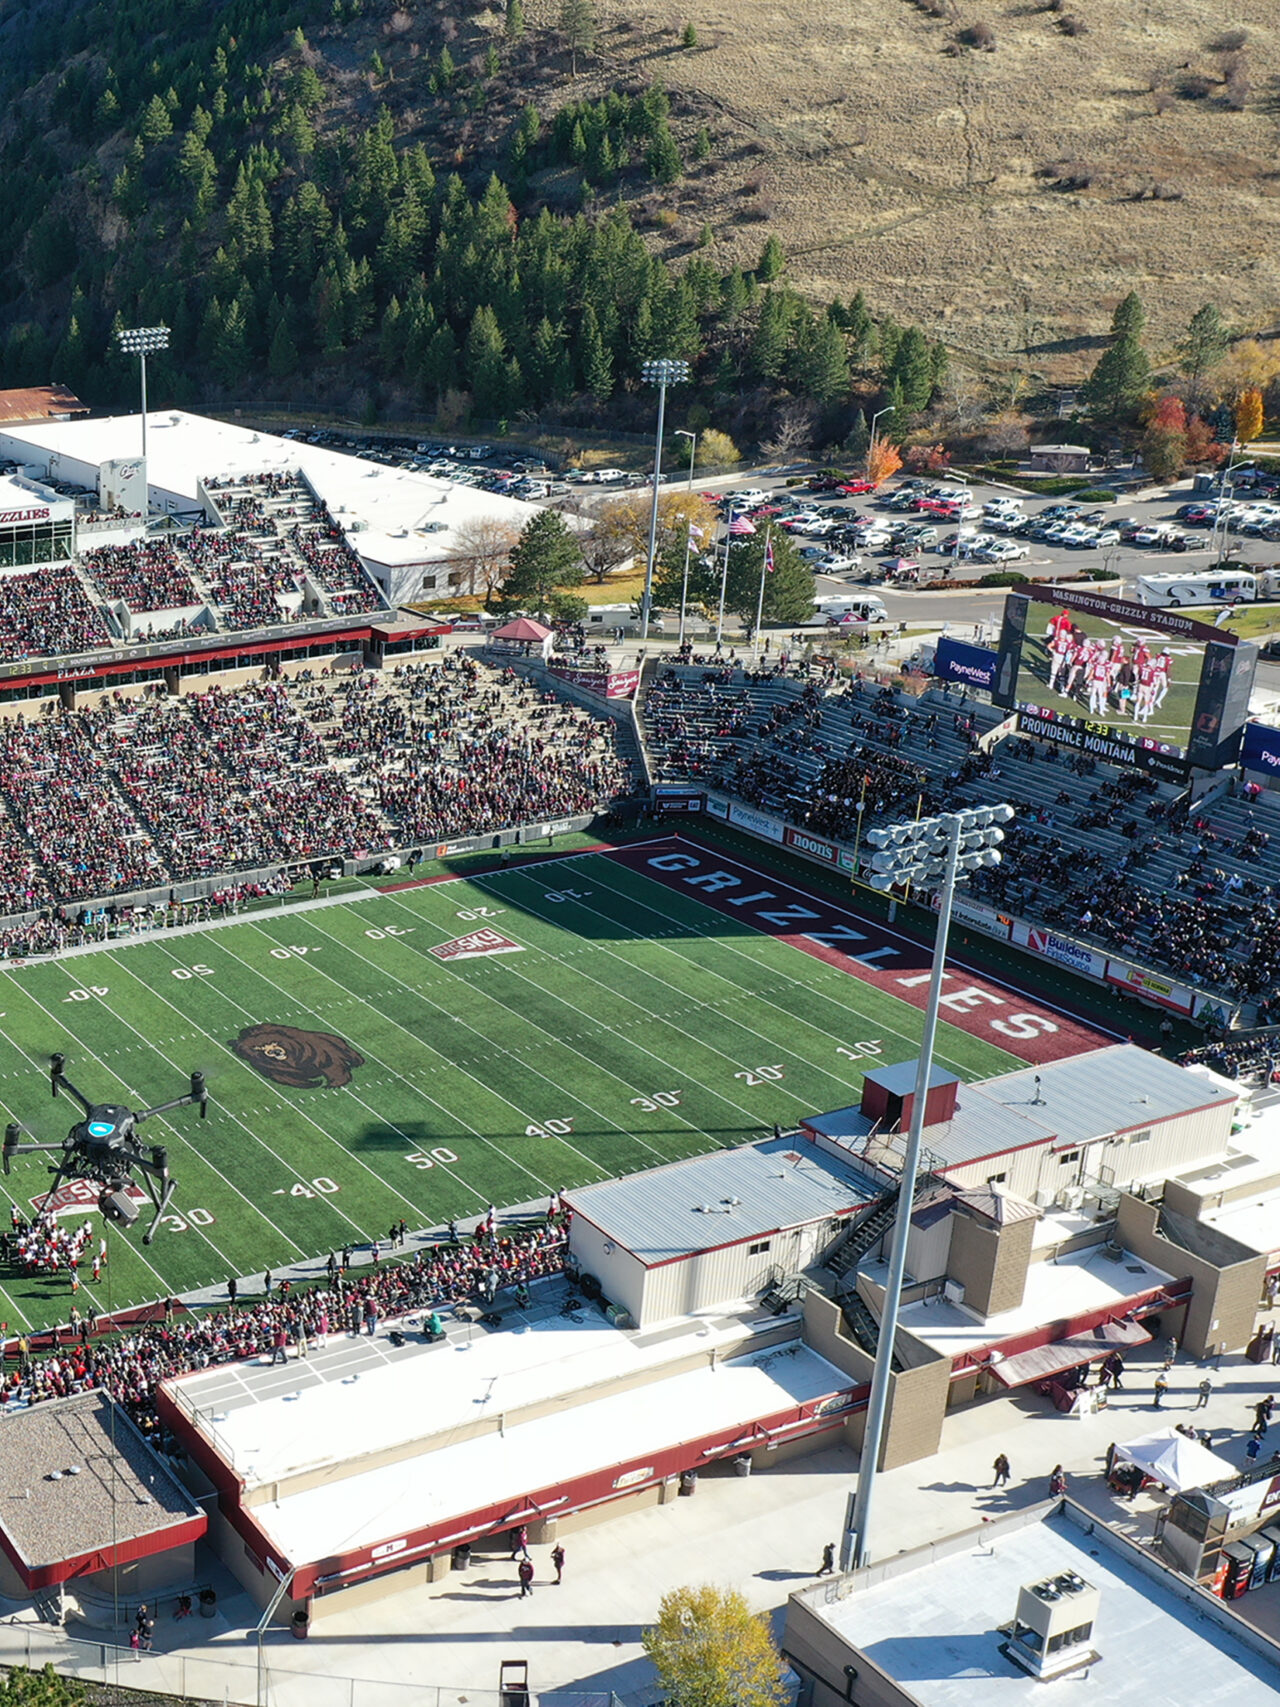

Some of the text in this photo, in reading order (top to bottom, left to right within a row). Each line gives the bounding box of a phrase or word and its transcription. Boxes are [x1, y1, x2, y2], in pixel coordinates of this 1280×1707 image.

[1052, 589, 1193, 631] WASHINGTON-GRIZZLY STADIUM
[115, 651, 124, 660] 19
[57, 665, 96, 679] PLAZA
[950, 661, 991, 680] PayneWest
[1041, 708, 1050, 717] 17
[1144, 738, 1154, 748] 19
[1021, 716, 1135, 764] PROVIDENCE MONTANA
[793, 833, 833, 859] noon's
[544, 888, 582, 903] 10
[456, 906, 496, 921] 20
[364, 925, 406, 940] 30
[433, 942, 462, 956] BIG
[457, 928, 504, 949] SKY
[270, 945, 308, 960] 40
[647, 853, 1060, 1040] GRIZZLIES
[1048, 935, 1092, 963] Builders
[1046, 946, 1091, 972] FirstSource
[170, 964, 215, 980] 50
[68, 985, 110, 1002] 40
[836, 1041, 882, 1061] 10
[734, 1065, 782, 1087] 20
[630, 1091, 681, 1113] 30
[525, 1118, 572, 1140] 40
[404, 1147, 458, 1170] 50
[289, 1176, 341, 1199] 40
[160, 1208, 216, 1233] 30
